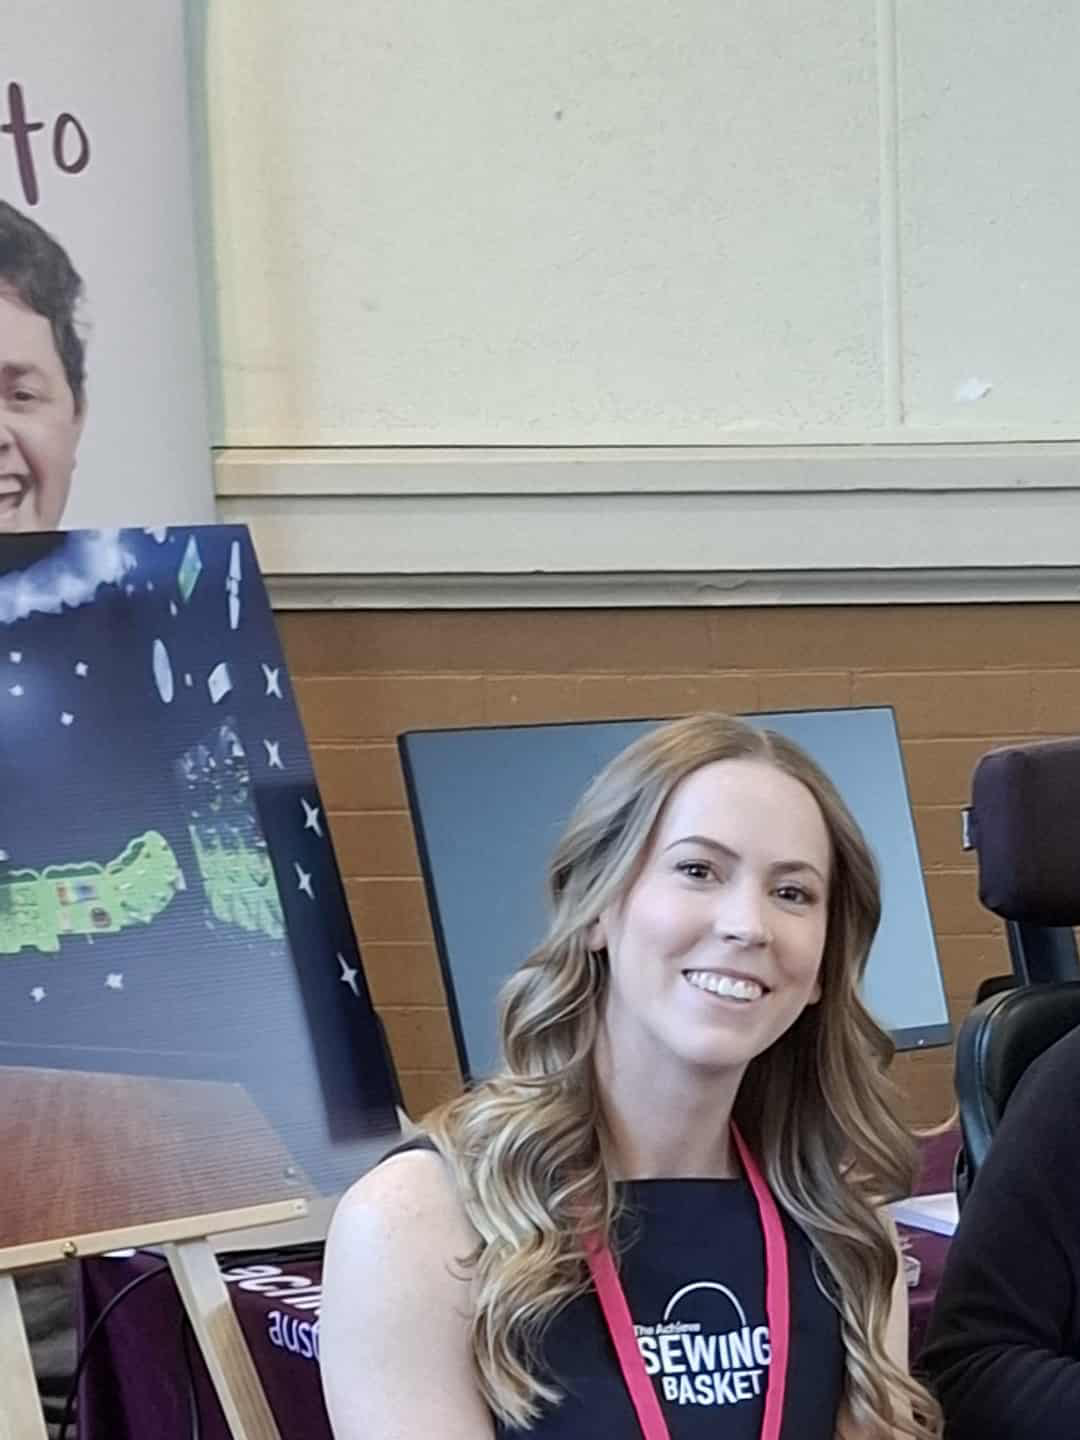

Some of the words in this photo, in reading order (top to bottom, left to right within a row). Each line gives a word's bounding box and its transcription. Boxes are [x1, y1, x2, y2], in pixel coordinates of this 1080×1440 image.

[0, 82, 91, 206] to
[636, 1325, 773, 1376] SEWING
[661, 1368, 764, 1406] BASKET
